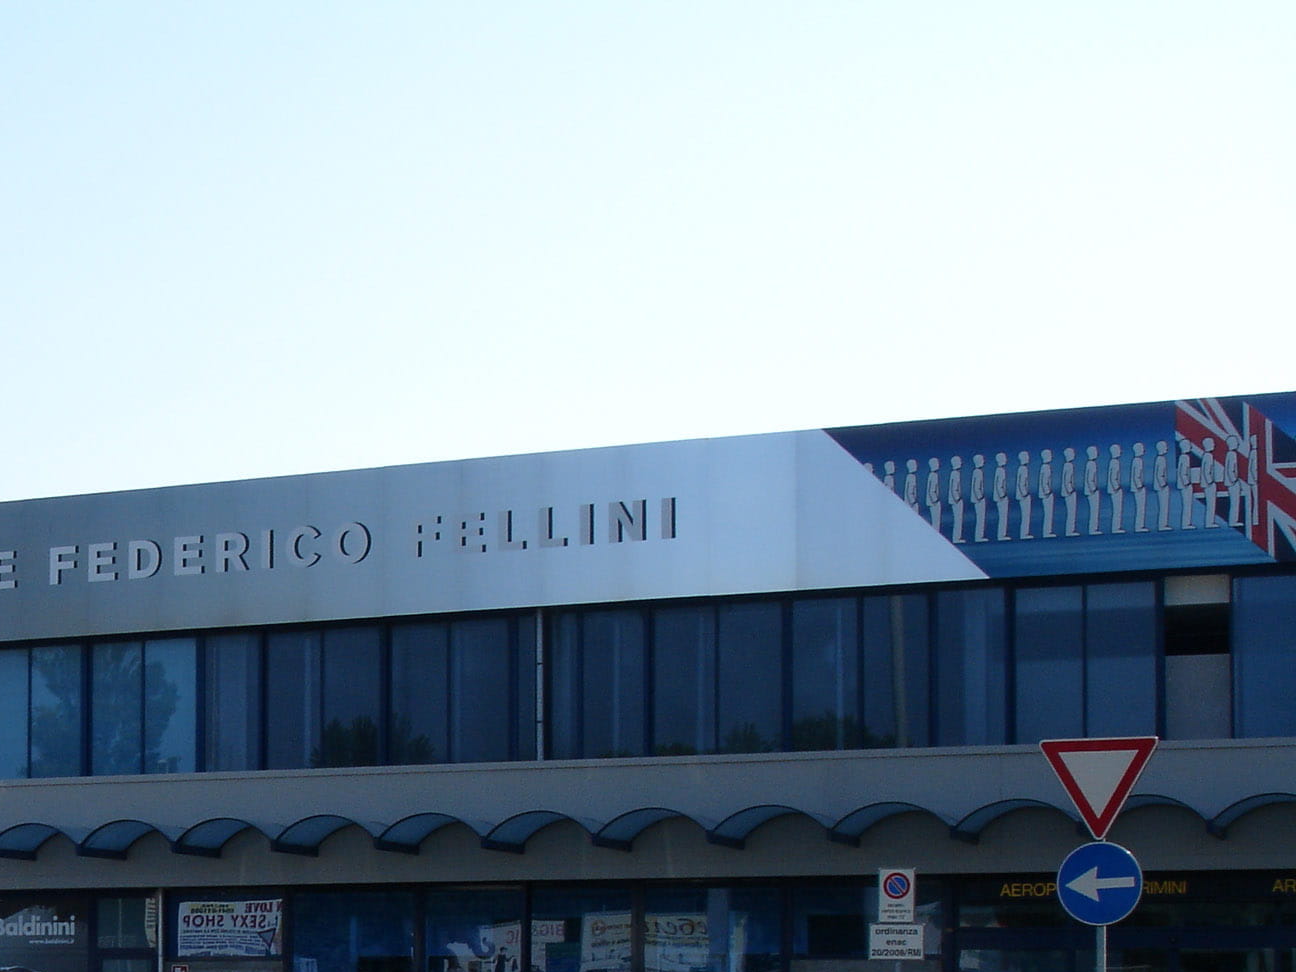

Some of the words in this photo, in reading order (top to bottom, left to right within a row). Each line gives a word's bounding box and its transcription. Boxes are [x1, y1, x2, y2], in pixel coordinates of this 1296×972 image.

[48, 521, 373, 585] FEDERICO
[415, 496, 677, 557] FELLINI
[1000, 883, 1056, 896] AEROP
[1143, 881, 1187, 894] RIMINI
